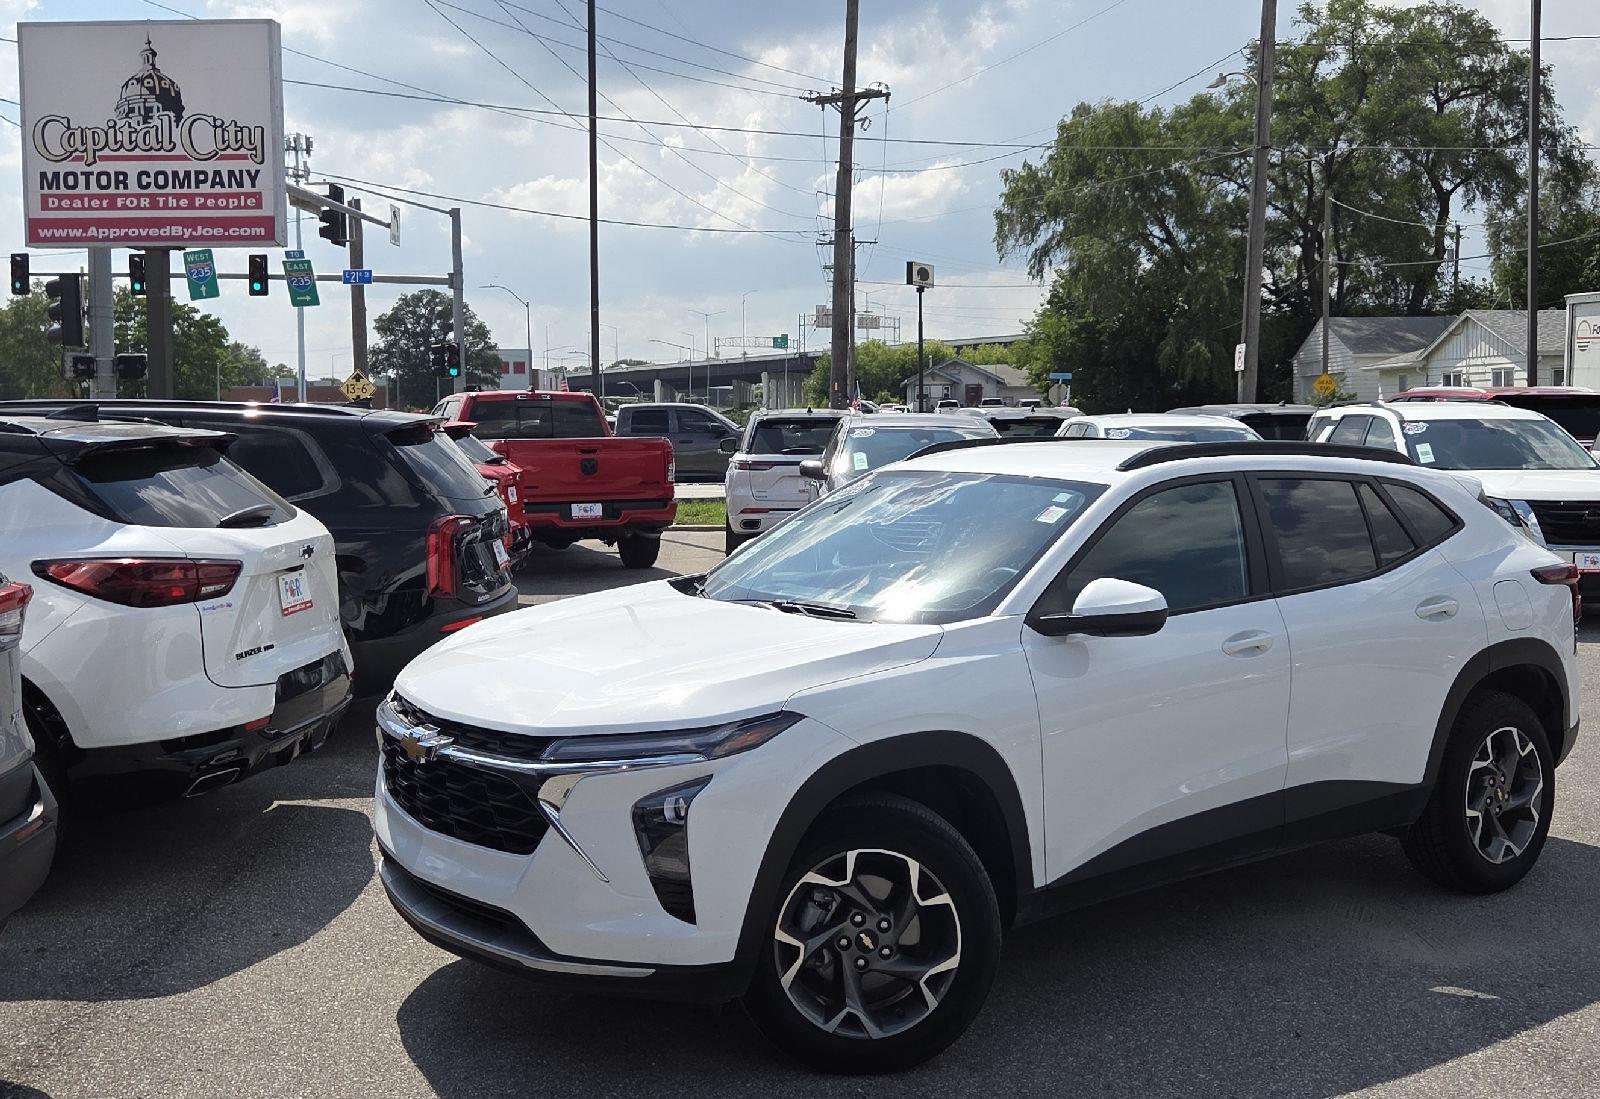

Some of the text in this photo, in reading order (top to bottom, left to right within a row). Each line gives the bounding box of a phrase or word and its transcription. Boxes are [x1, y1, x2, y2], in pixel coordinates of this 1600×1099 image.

[33, 112, 264, 166] Capital City
[39, 169, 261, 191] MOTOR COMPANY
[48, 194, 257, 208] Dealer FOR The People
[38, 224, 265, 239] www.ApprovedByJoe.com
[187, 252, 210, 262] WEST
[191, 266, 211, 279] 235
[286, 261, 309, 271] EAST
[291, 275, 311, 286] 235
